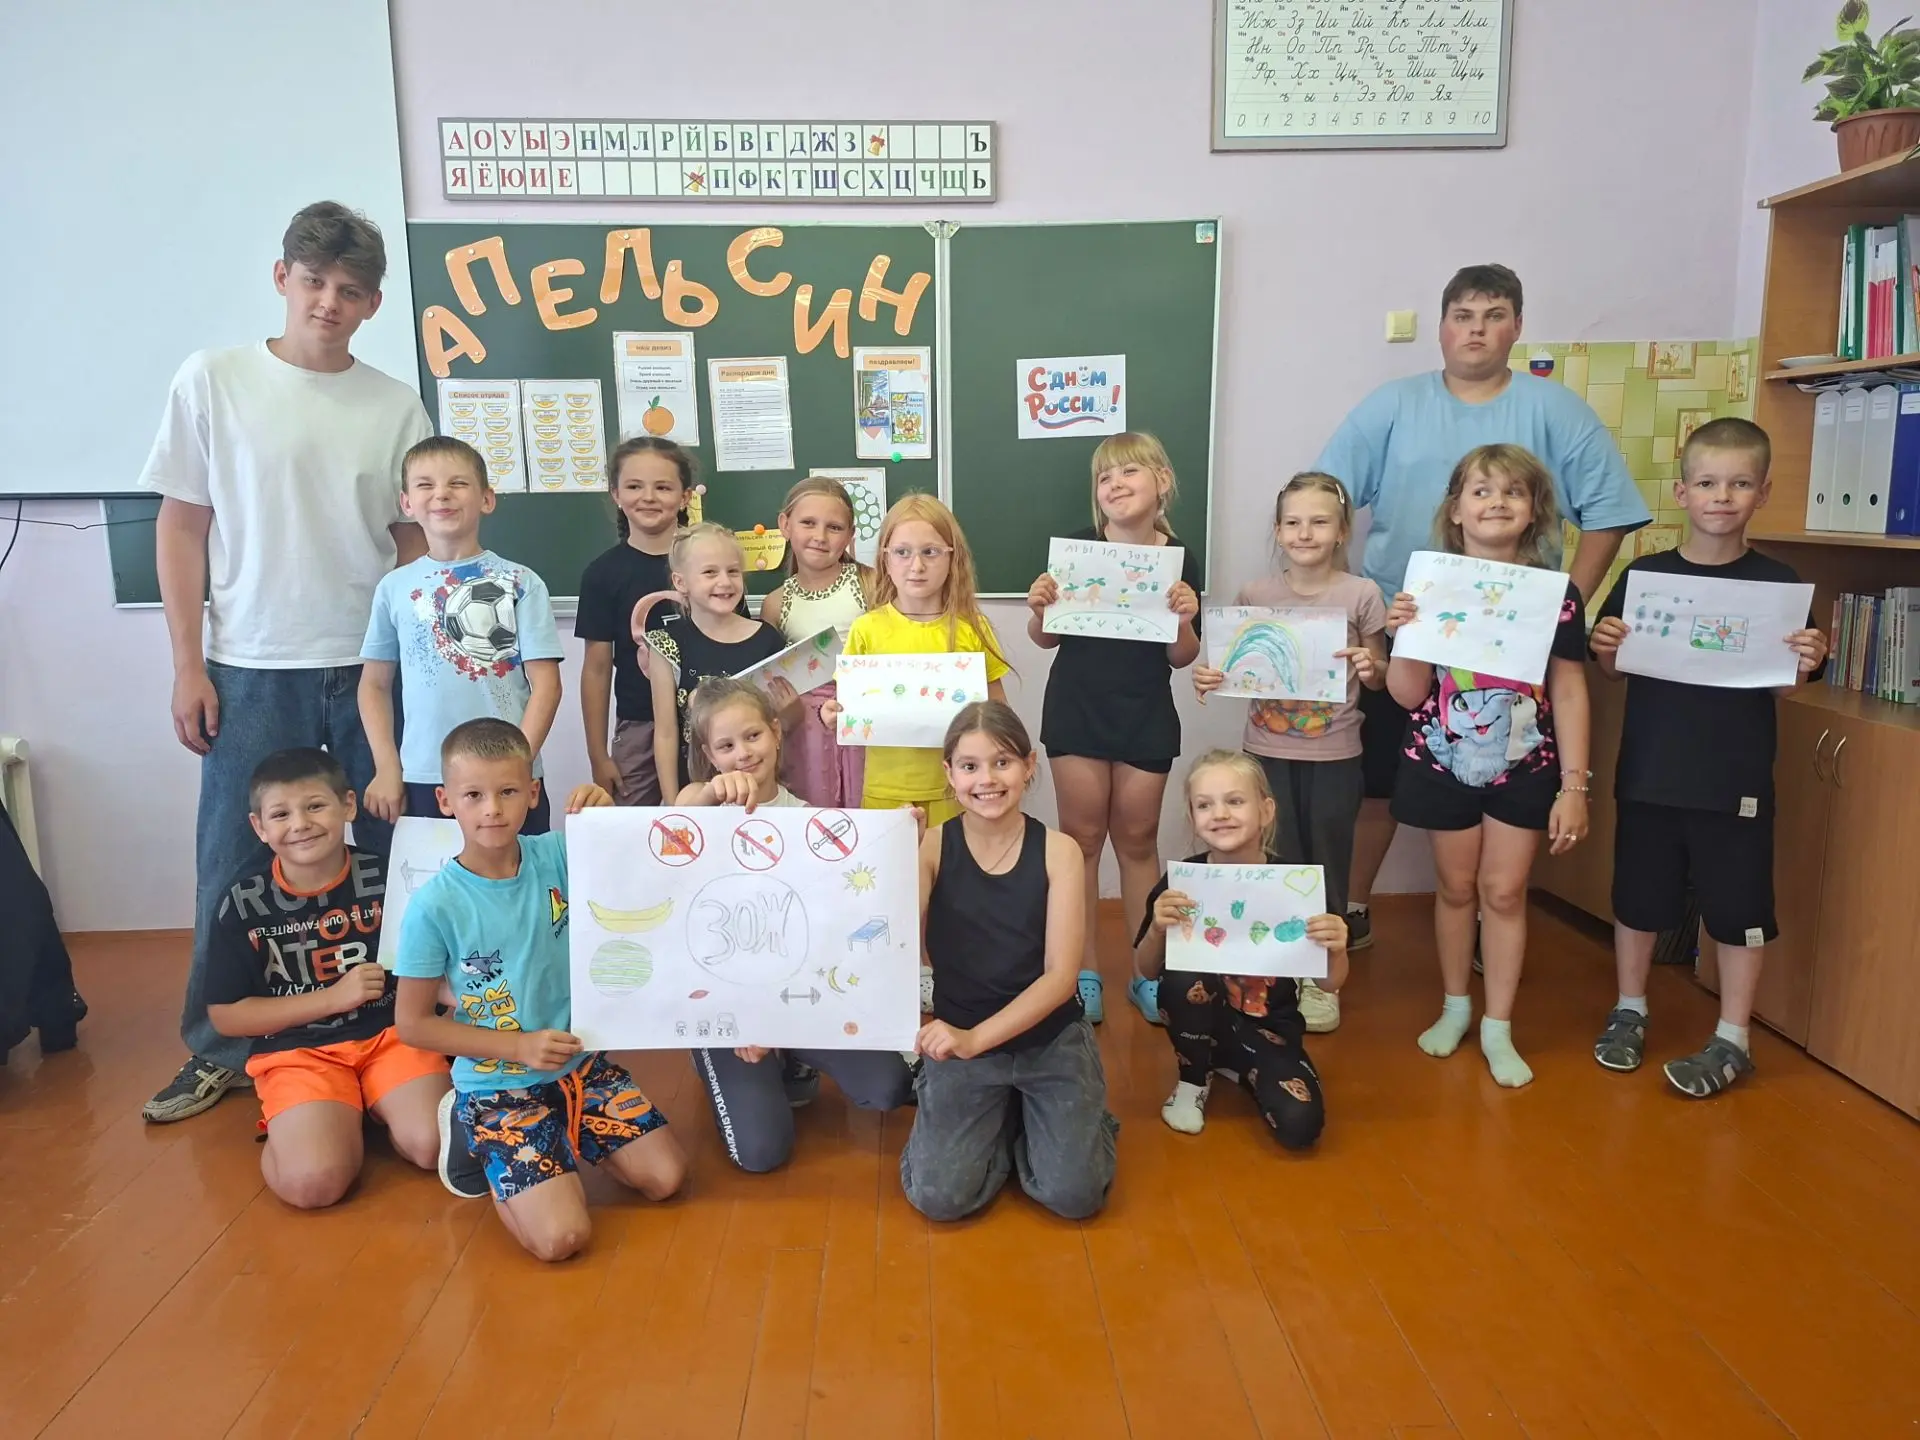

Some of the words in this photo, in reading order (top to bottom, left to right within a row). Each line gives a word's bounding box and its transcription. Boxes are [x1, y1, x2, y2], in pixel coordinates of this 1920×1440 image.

[1237, 114, 1246, 127] 0
[1263, 114, 1270, 127] 1
[1284, 114, 1293, 127] 2
[1308, 112, 1316, 126] 3
[1332, 112, 1340, 126] 4
[1353, 112, 1363, 126] 5
[1378, 112, 1386, 125] 6
[1400, 112, 1410, 125] 7
[1425, 112, 1433, 125] 8
[1450, 112, 1456, 125] 9
[1472, 112, 1491, 125] 10
[422, 227, 931, 377] АПЕЛЬСИН
[699, 890, 795, 966] ЗОЖ
